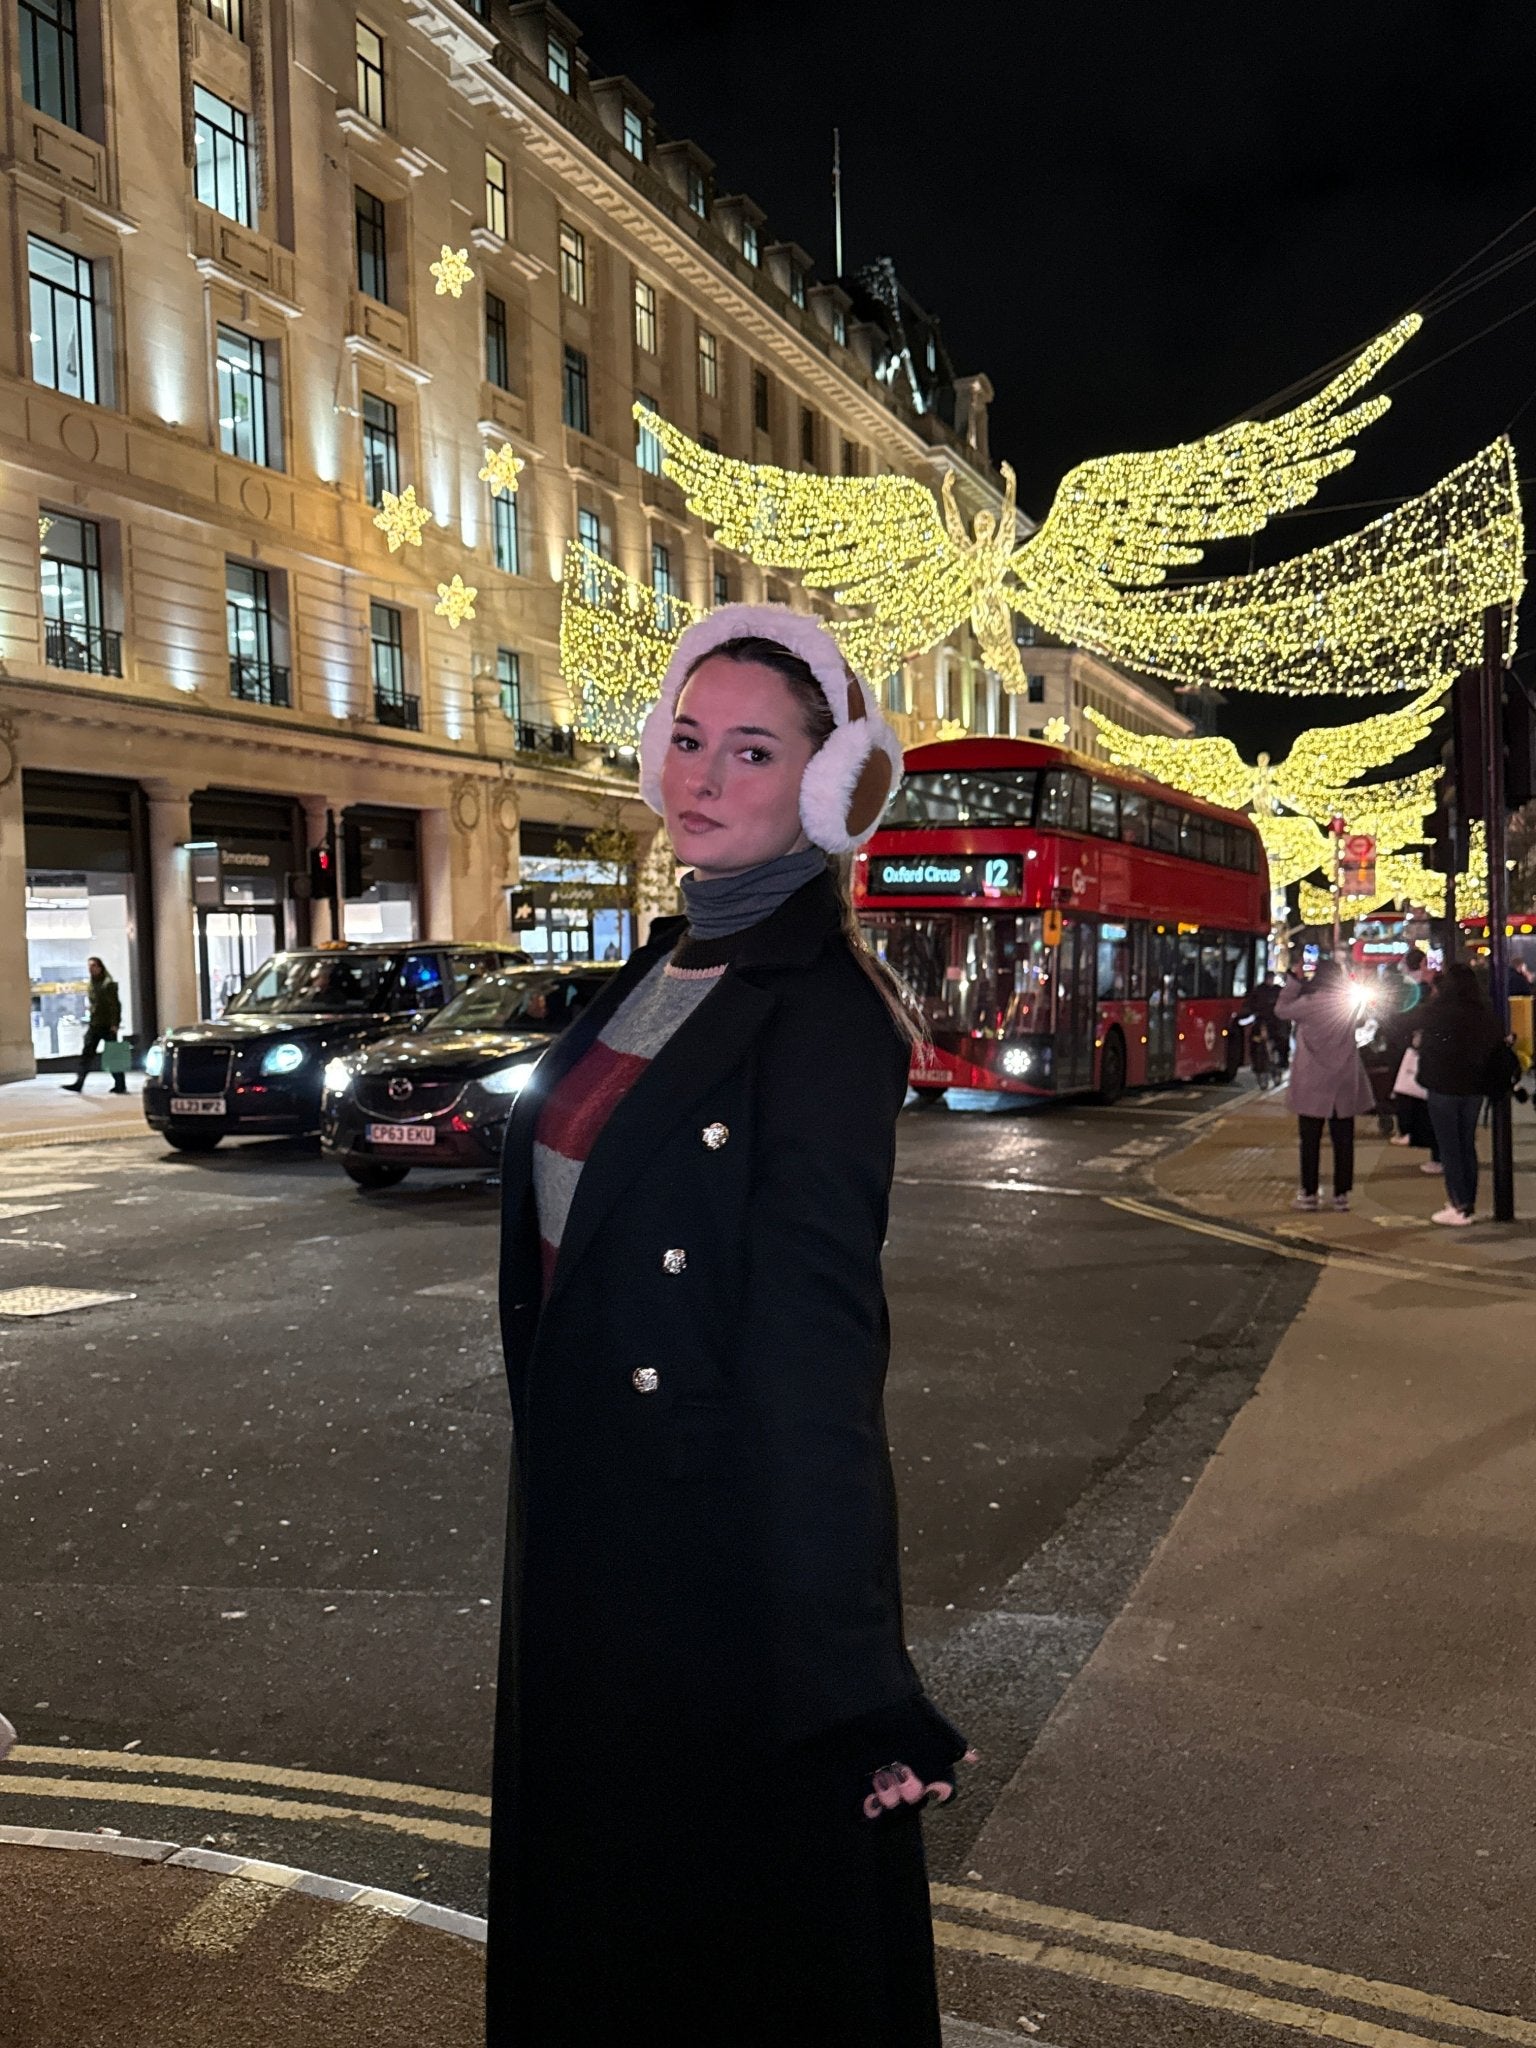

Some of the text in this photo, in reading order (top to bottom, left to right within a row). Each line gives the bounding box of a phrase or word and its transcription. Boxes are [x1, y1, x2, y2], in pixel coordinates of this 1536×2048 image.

[883, 866, 961, 883] Oxford Circus
[985, 859, 1009, 887] 12
